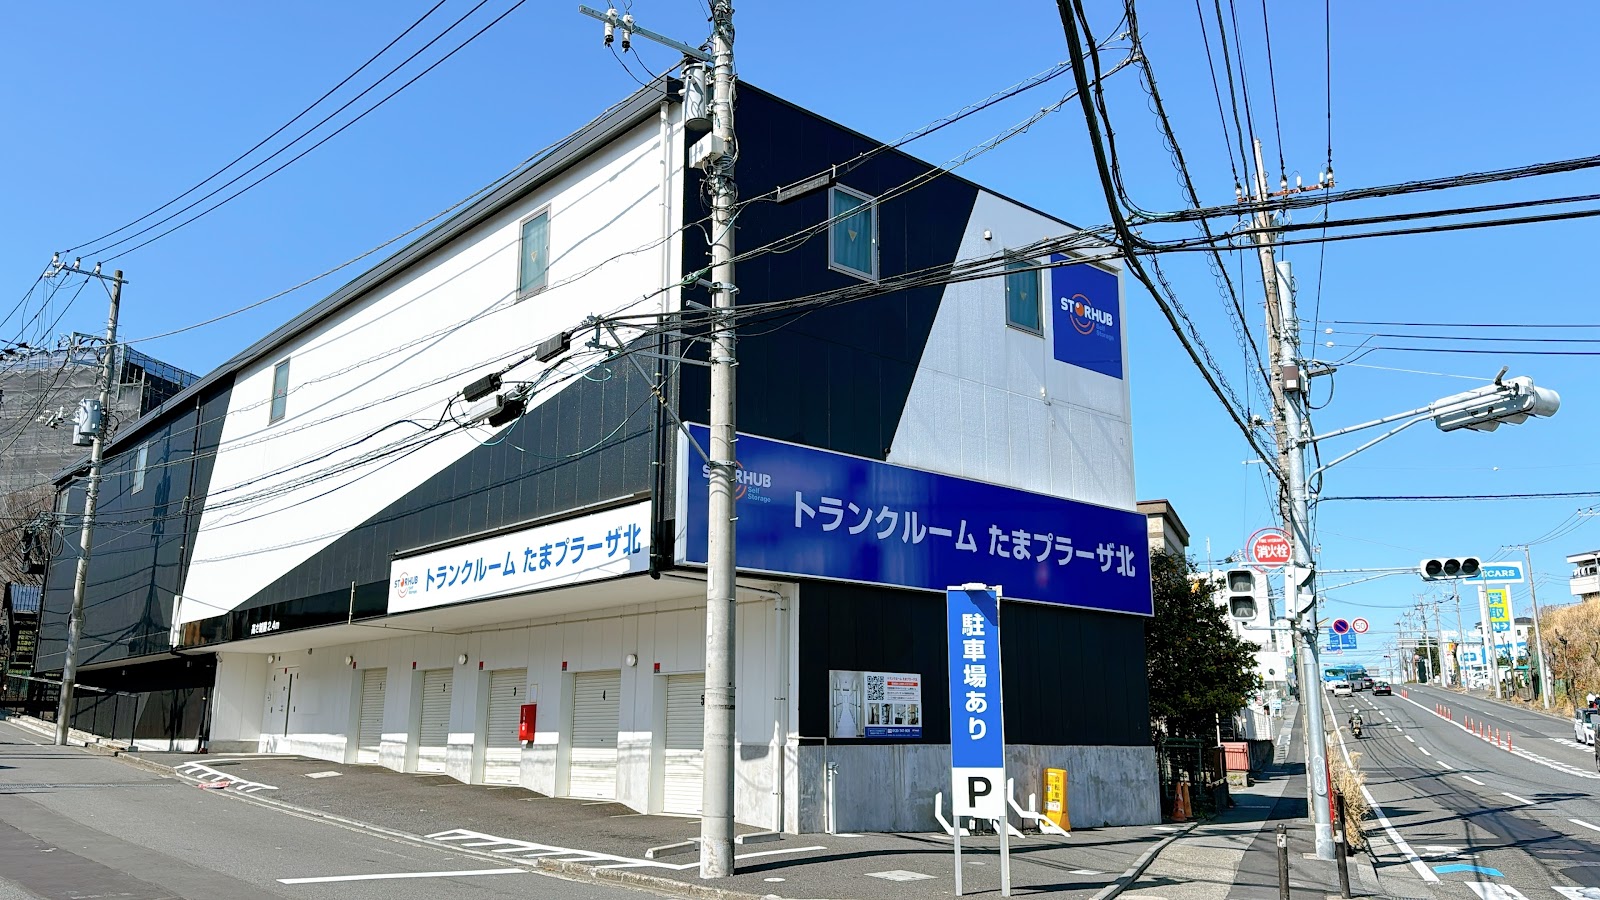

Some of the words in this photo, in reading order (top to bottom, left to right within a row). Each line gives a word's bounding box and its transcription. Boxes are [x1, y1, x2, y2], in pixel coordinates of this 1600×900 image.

[1060, 296, 1113, 327] STORHUB
[702, 463, 772, 488] SRHUB
[748, 486, 760, 494] Self
[748, 493, 771, 503] Storage
[794, 490, 977, 553] トランクルーム
[988, 524, 1136, 577] たまプラーザ北
[425, 551, 516, 592] トランクルーム
[523, 523, 642, 573] たまプラーザ北
[1256, 543, 1289, 558] 消火栓
[1355, 622, 1366, 630] 50
[962, 613, 988, 740] 駐車場あり
[967, 776, 992, 808] P
